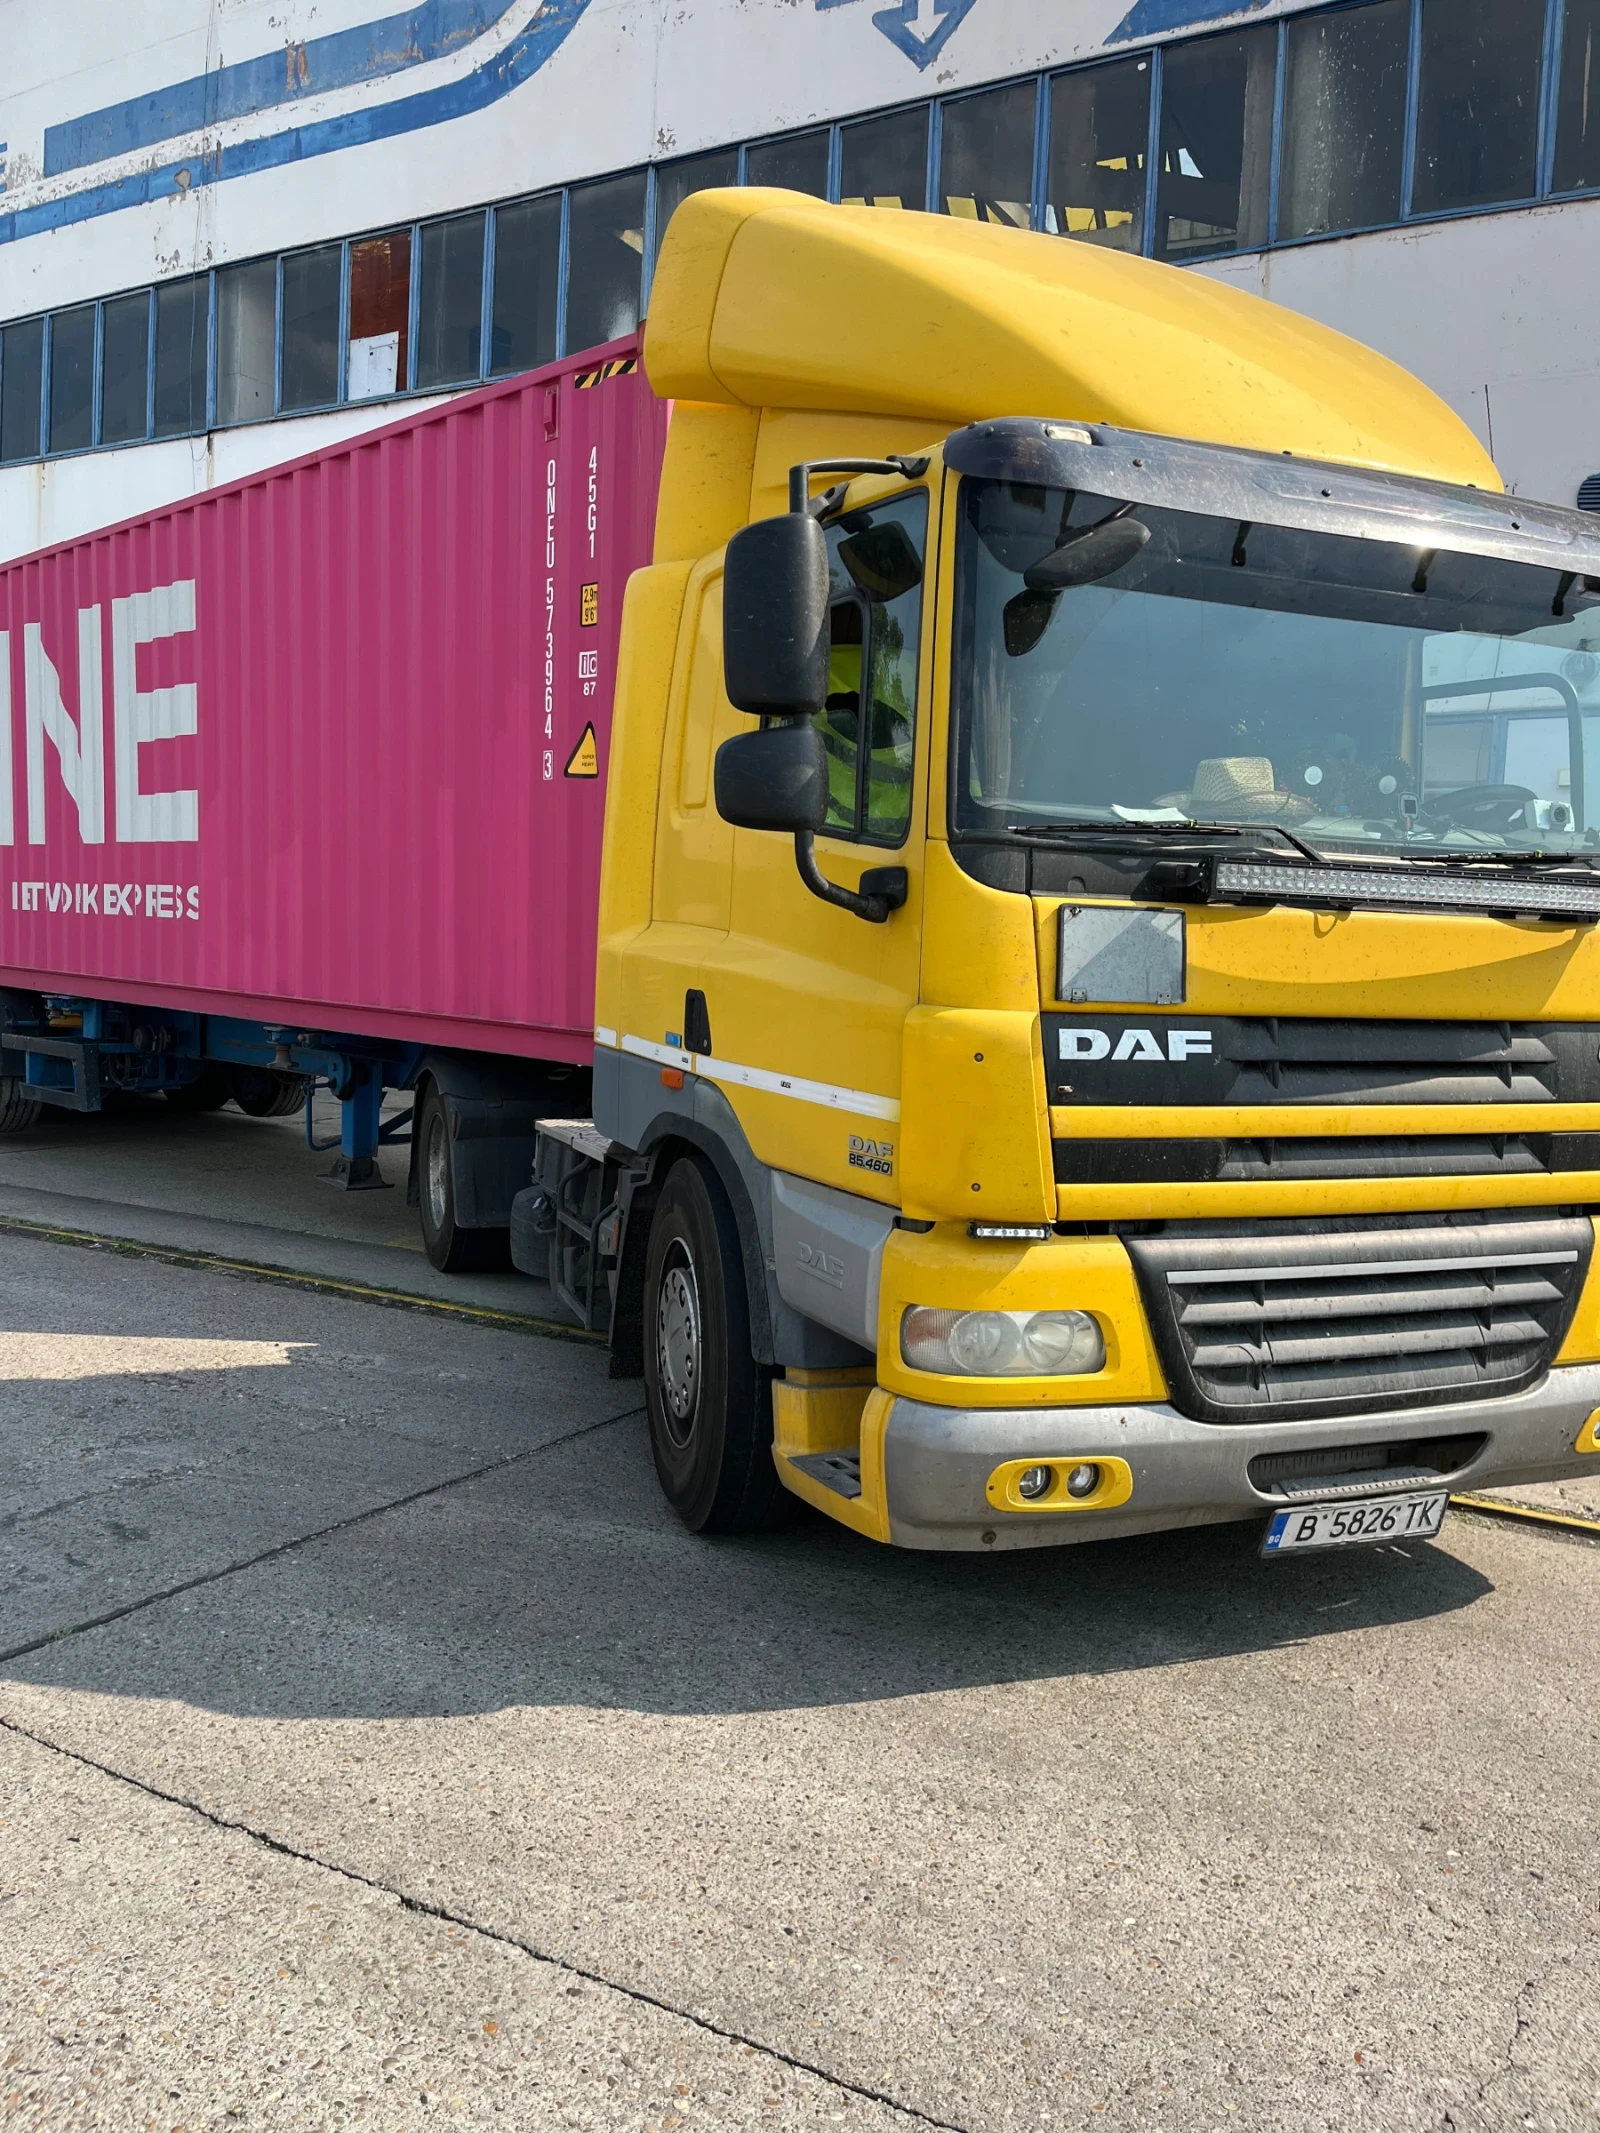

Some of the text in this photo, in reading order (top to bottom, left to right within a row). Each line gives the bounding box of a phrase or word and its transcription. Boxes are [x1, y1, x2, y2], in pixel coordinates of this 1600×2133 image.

[587, 446, 597, 558] 45G1
[544, 459, 555, 779] ONEU 573964 3
[583, 681, 597, 696] 87
[0, 579, 198, 845] NE
[1058, 1028, 1213, 1061] DAF
[848, 1135, 894, 1157] DAF
[849, 1152, 892, 1174] 85.460
[796, 1241, 844, 1277] DAF
[1295, 1499, 1439, 1542] B 5826 TK
[1267, 1534, 1281, 1545] BG
